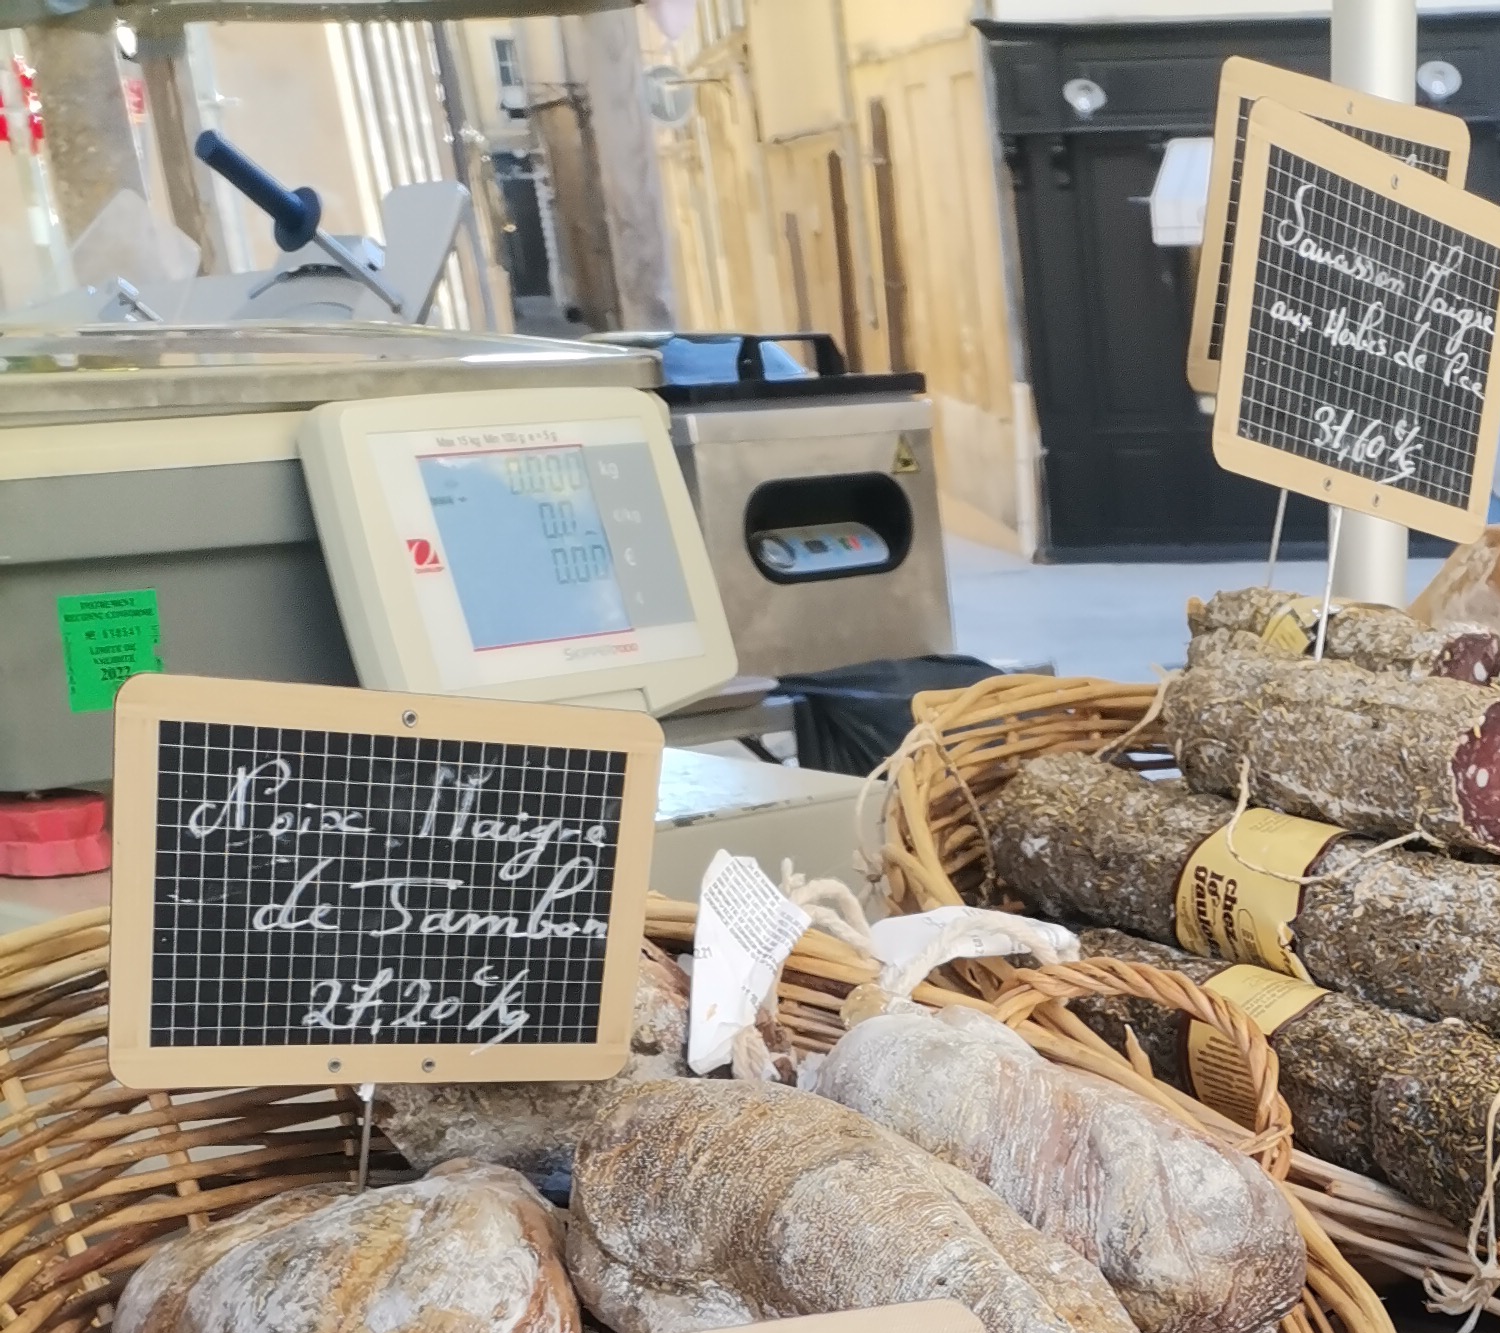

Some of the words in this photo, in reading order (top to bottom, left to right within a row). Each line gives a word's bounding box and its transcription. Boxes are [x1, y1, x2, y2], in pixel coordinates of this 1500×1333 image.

[1392, 321, 1430, 374] de
[190, 757, 374, 839] Noix
[419, 765, 609, 881] Maigre
[252, 858, 341, 931] de
[349, 856, 610, 940] Jambon
